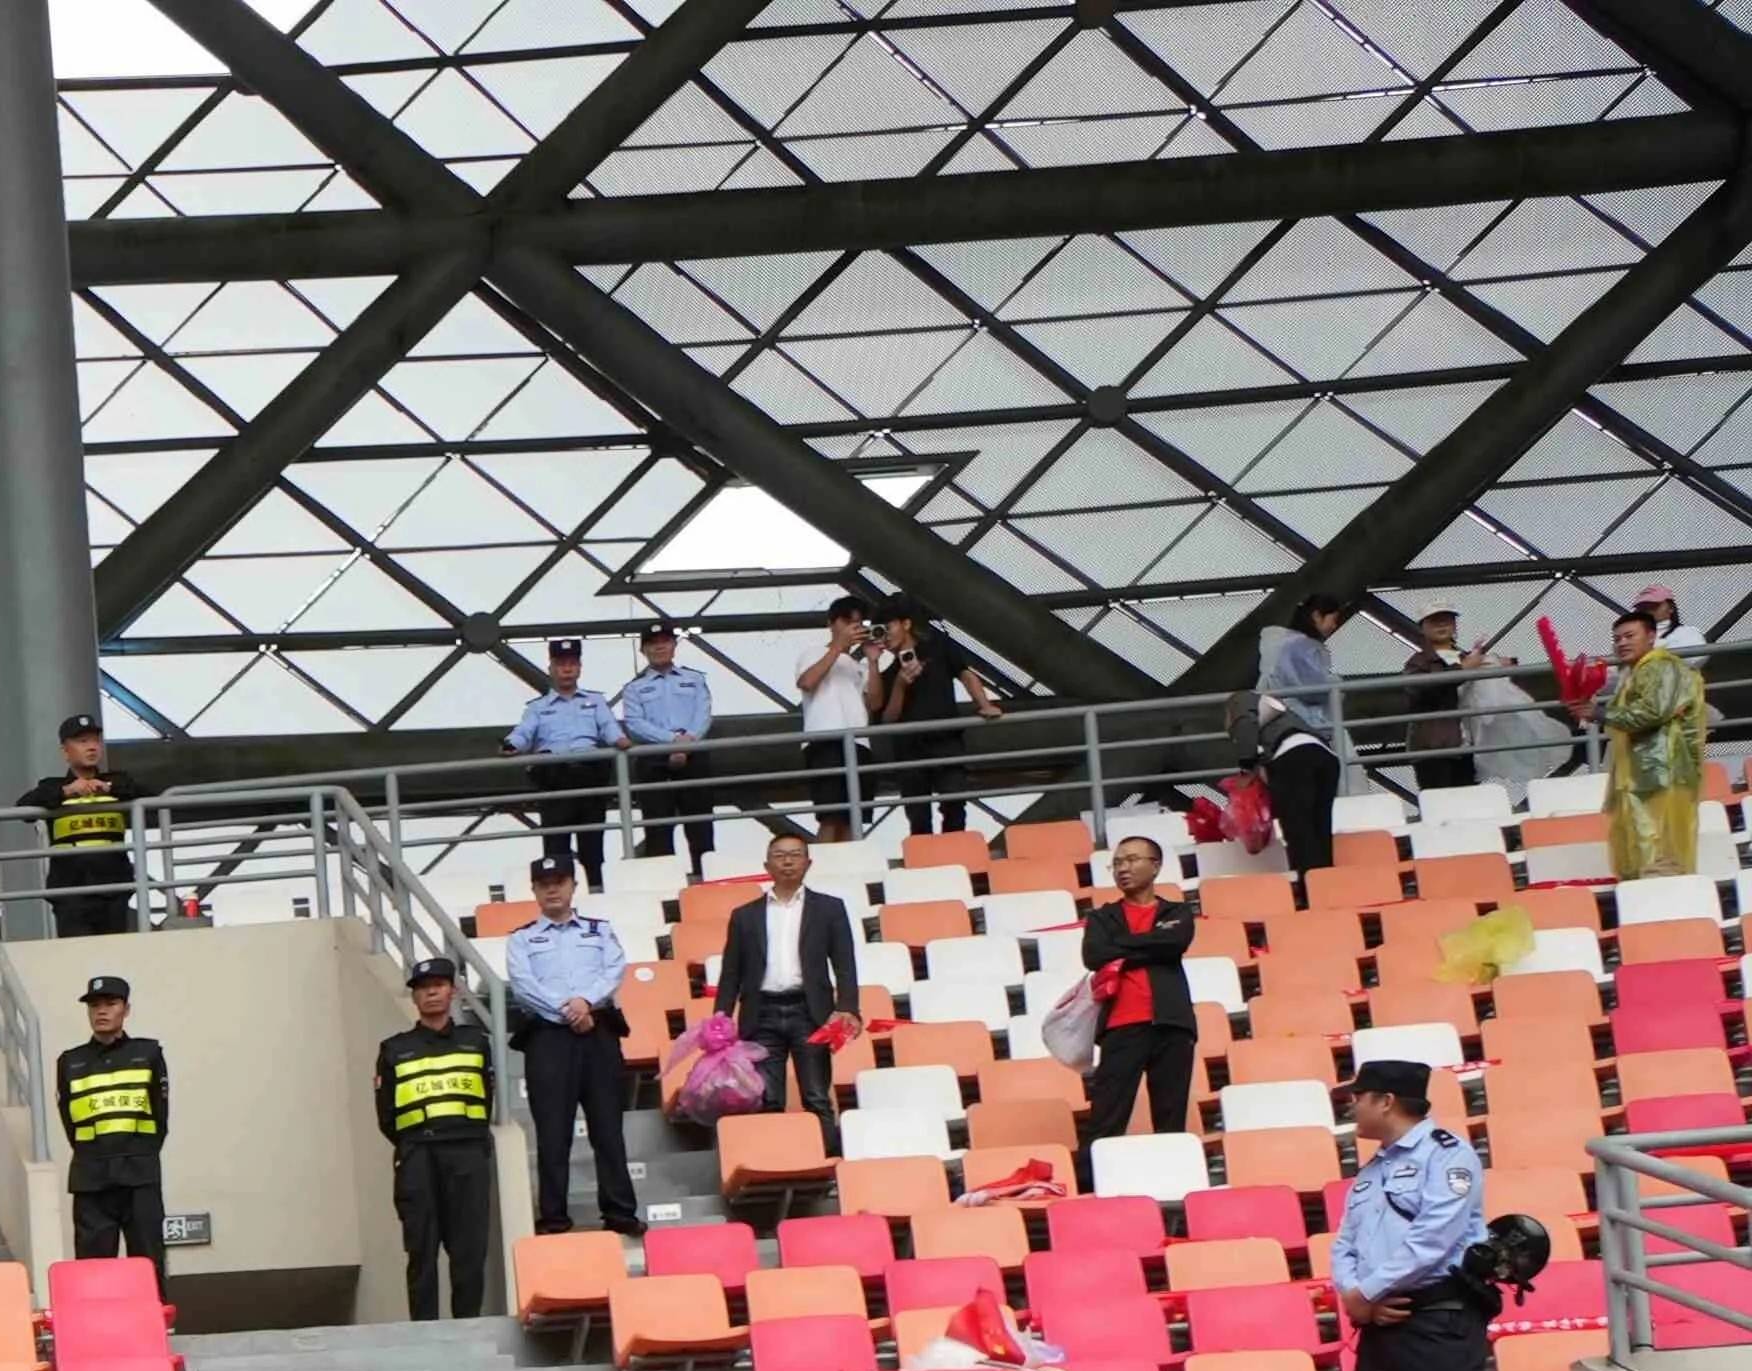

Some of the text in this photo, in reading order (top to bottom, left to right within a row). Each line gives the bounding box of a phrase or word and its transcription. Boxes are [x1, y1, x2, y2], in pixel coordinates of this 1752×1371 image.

[416, 1077, 474, 1093] 亿城保安
[88, 1095, 146, 1111] 亿城保安
